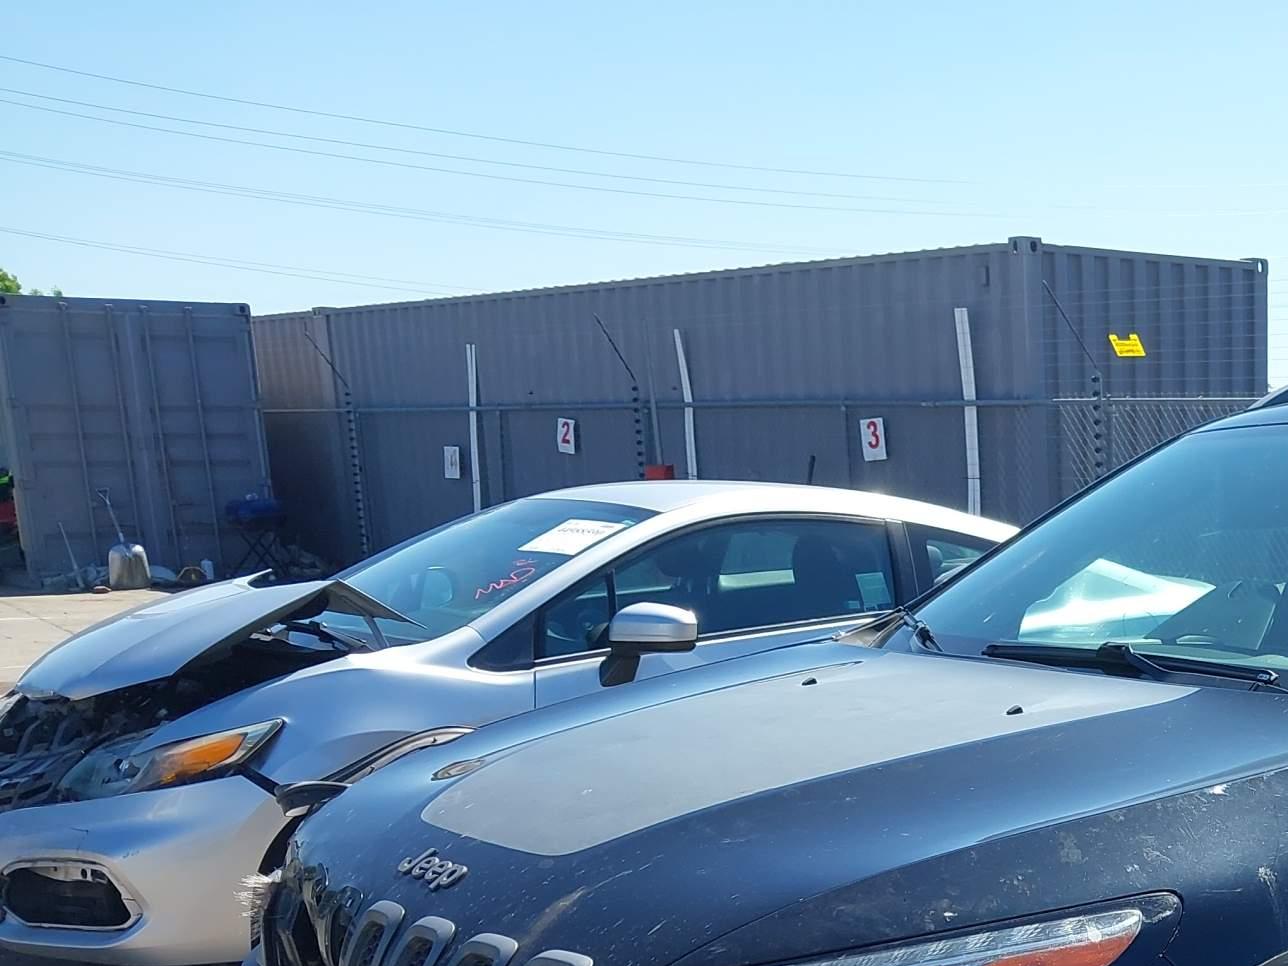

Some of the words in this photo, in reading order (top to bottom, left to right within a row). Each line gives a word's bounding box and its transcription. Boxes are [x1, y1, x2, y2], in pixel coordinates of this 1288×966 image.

[560, 421, 571, 444] 2
[867, 420, 880, 449] 3
[397, 847, 468, 890] Jeep
